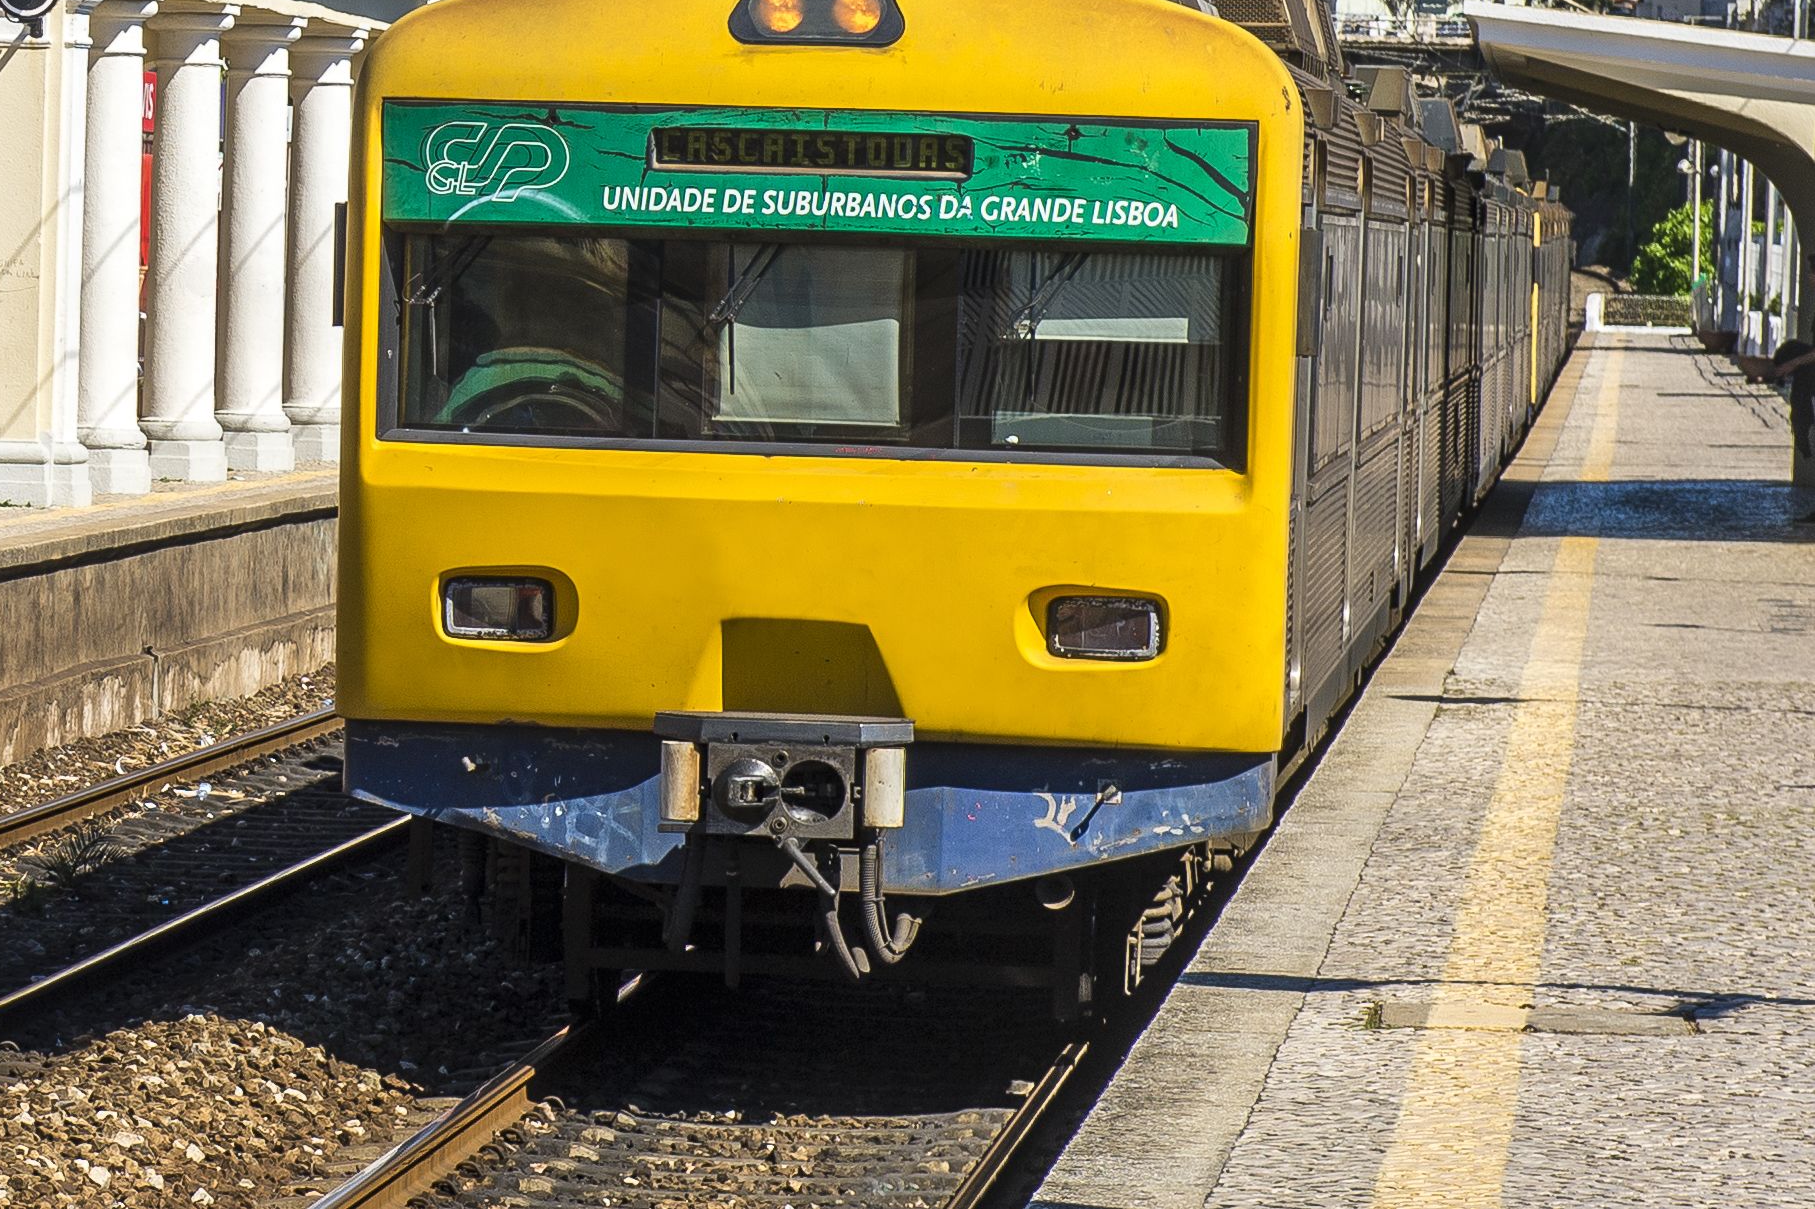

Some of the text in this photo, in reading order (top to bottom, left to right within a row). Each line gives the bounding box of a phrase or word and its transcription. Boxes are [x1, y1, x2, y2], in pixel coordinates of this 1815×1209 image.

[602, 186, 1180, 228] UNIDADE DE SUBURBANOS DA GRANDE LISBOA
